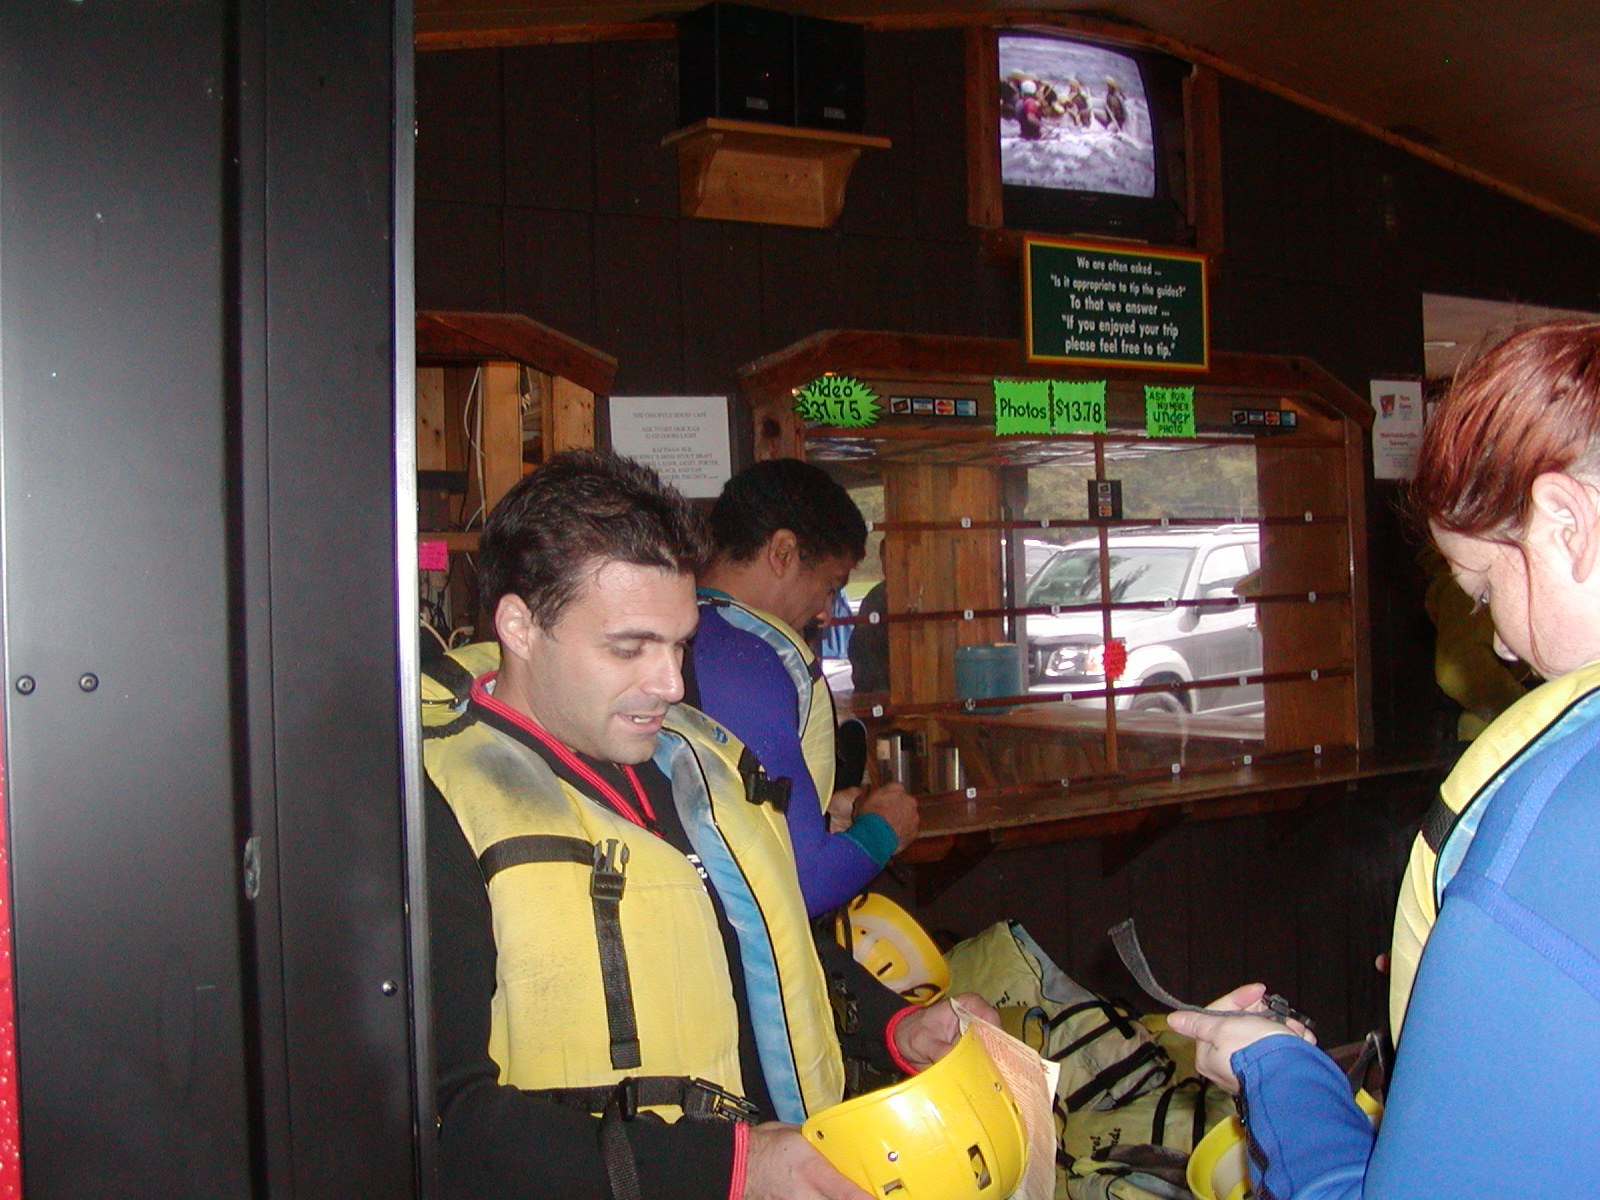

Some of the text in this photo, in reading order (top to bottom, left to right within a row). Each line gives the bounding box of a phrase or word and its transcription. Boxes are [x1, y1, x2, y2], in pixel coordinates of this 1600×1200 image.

[1077, 256, 1090, 269] We
[1092, 260, 1105, 271] are
[1108, 259, 1128, 272] often
[1130, 262, 1152, 275] asked
[1064, 276, 1070, 287] it
[1073, 279, 1116, 293] appropriate
[1119, 281, 1127, 292] to
[1129, 281, 1139, 297] tip
[1142, 283, 1154, 295] the
[1070, 294, 1080, 309] To
[1085, 295, 1104, 311] that
[1108, 302, 1122, 313] we
[1125, 303, 1157, 316] answer
[1078, 319, 1095, 334] you
[1099, 318, 1136, 337] enjoyed
[1139, 323, 1159, 338] your
[1163, 322, 1179, 340] trip
[1065, 336, 1096, 354] please
[1100, 338, 1117, 354] feel
[1121, 339, 1140, 355] free
[1143, 342, 1153, 355] to
[808, 380, 853, 398] Video
[801, 399, 862, 420] $31.75
[1000, 398, 1102, 424] Photos $13.78
